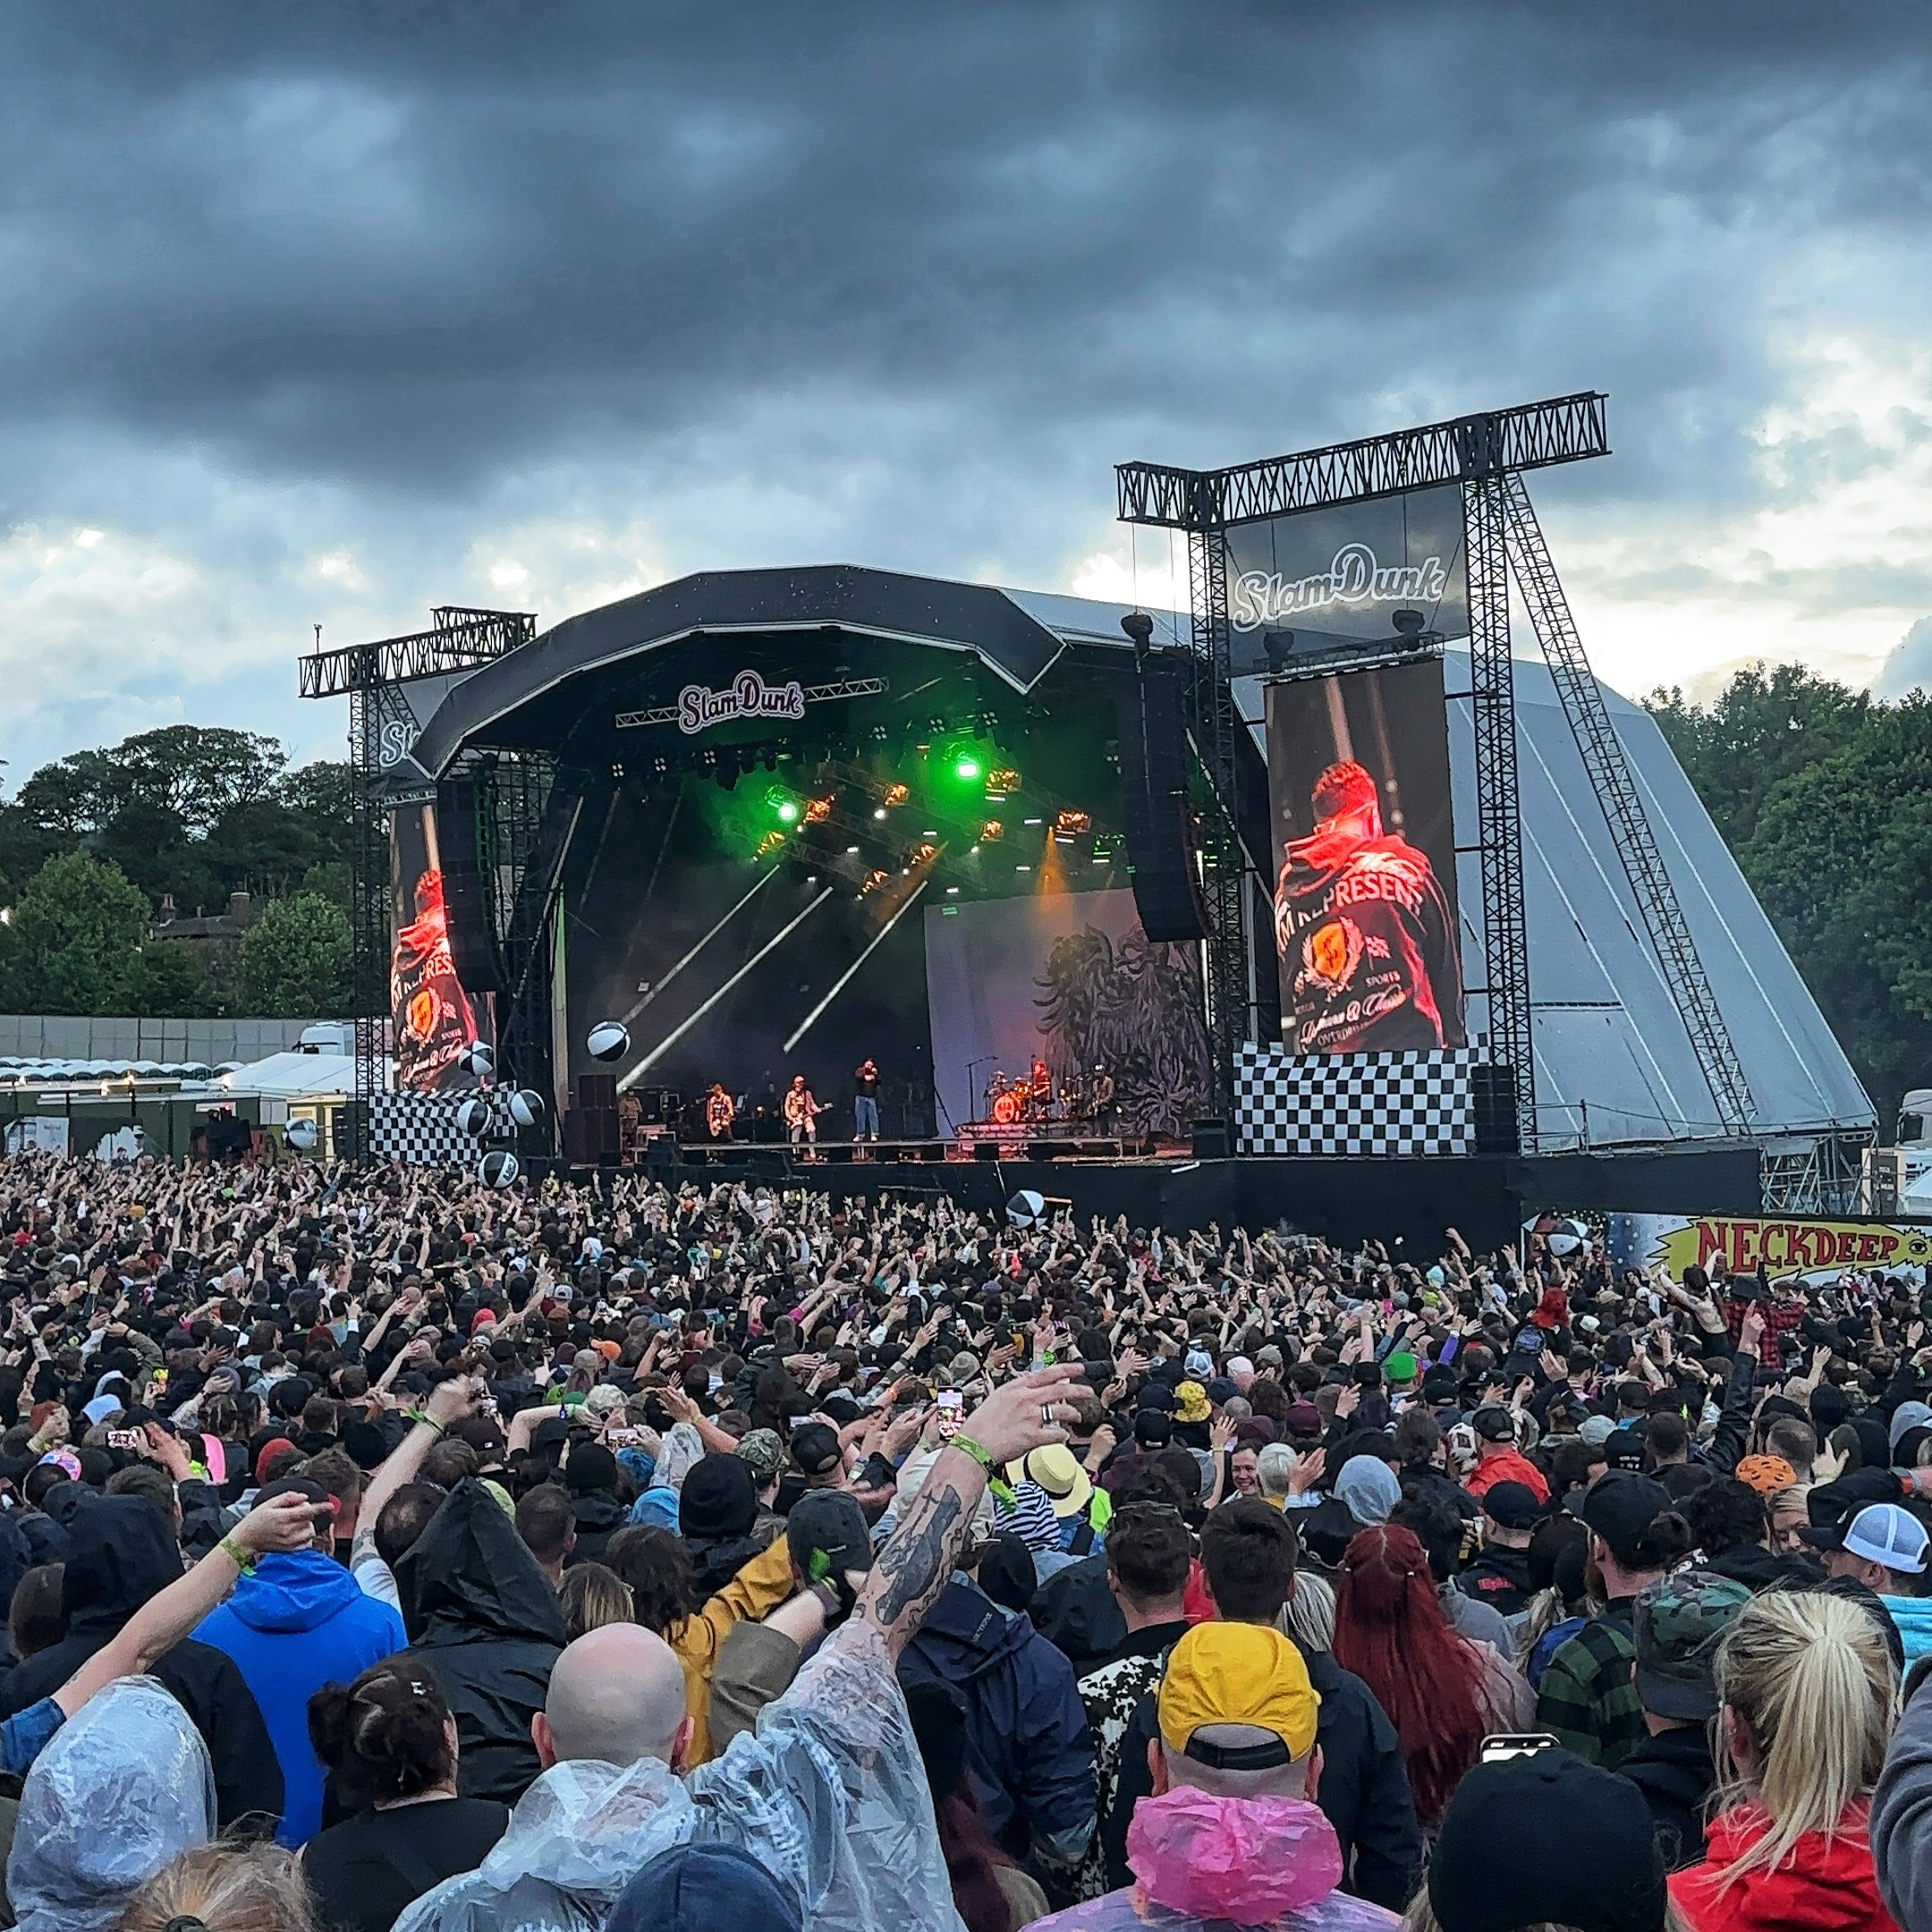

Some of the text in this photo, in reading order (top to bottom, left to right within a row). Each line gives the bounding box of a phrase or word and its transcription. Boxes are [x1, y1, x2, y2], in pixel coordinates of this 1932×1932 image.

[1233, 542, 1445, 633] Slam Dunk
[680, 670, 804, 734] Slam Dunk
